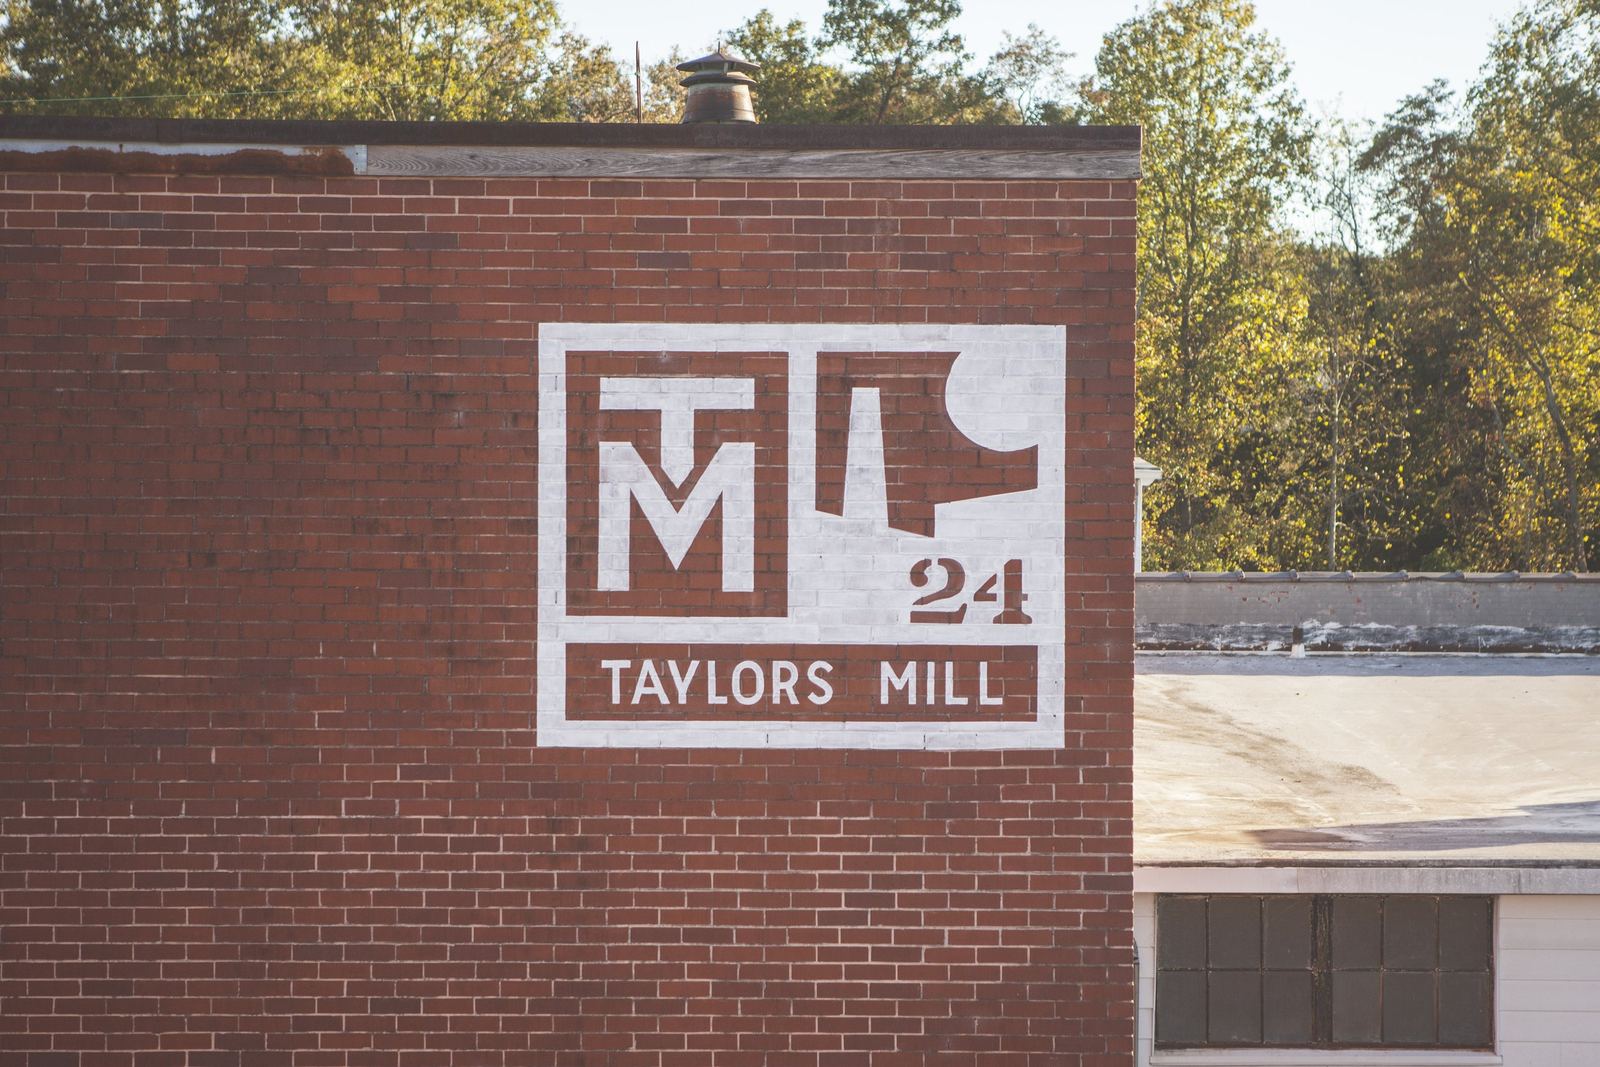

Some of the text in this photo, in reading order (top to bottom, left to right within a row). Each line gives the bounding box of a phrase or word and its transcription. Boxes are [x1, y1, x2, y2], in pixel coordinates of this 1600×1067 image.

[909, 557, 1033, 625] 24
[600, 659, 1004, 706] TAYLORS MILL
